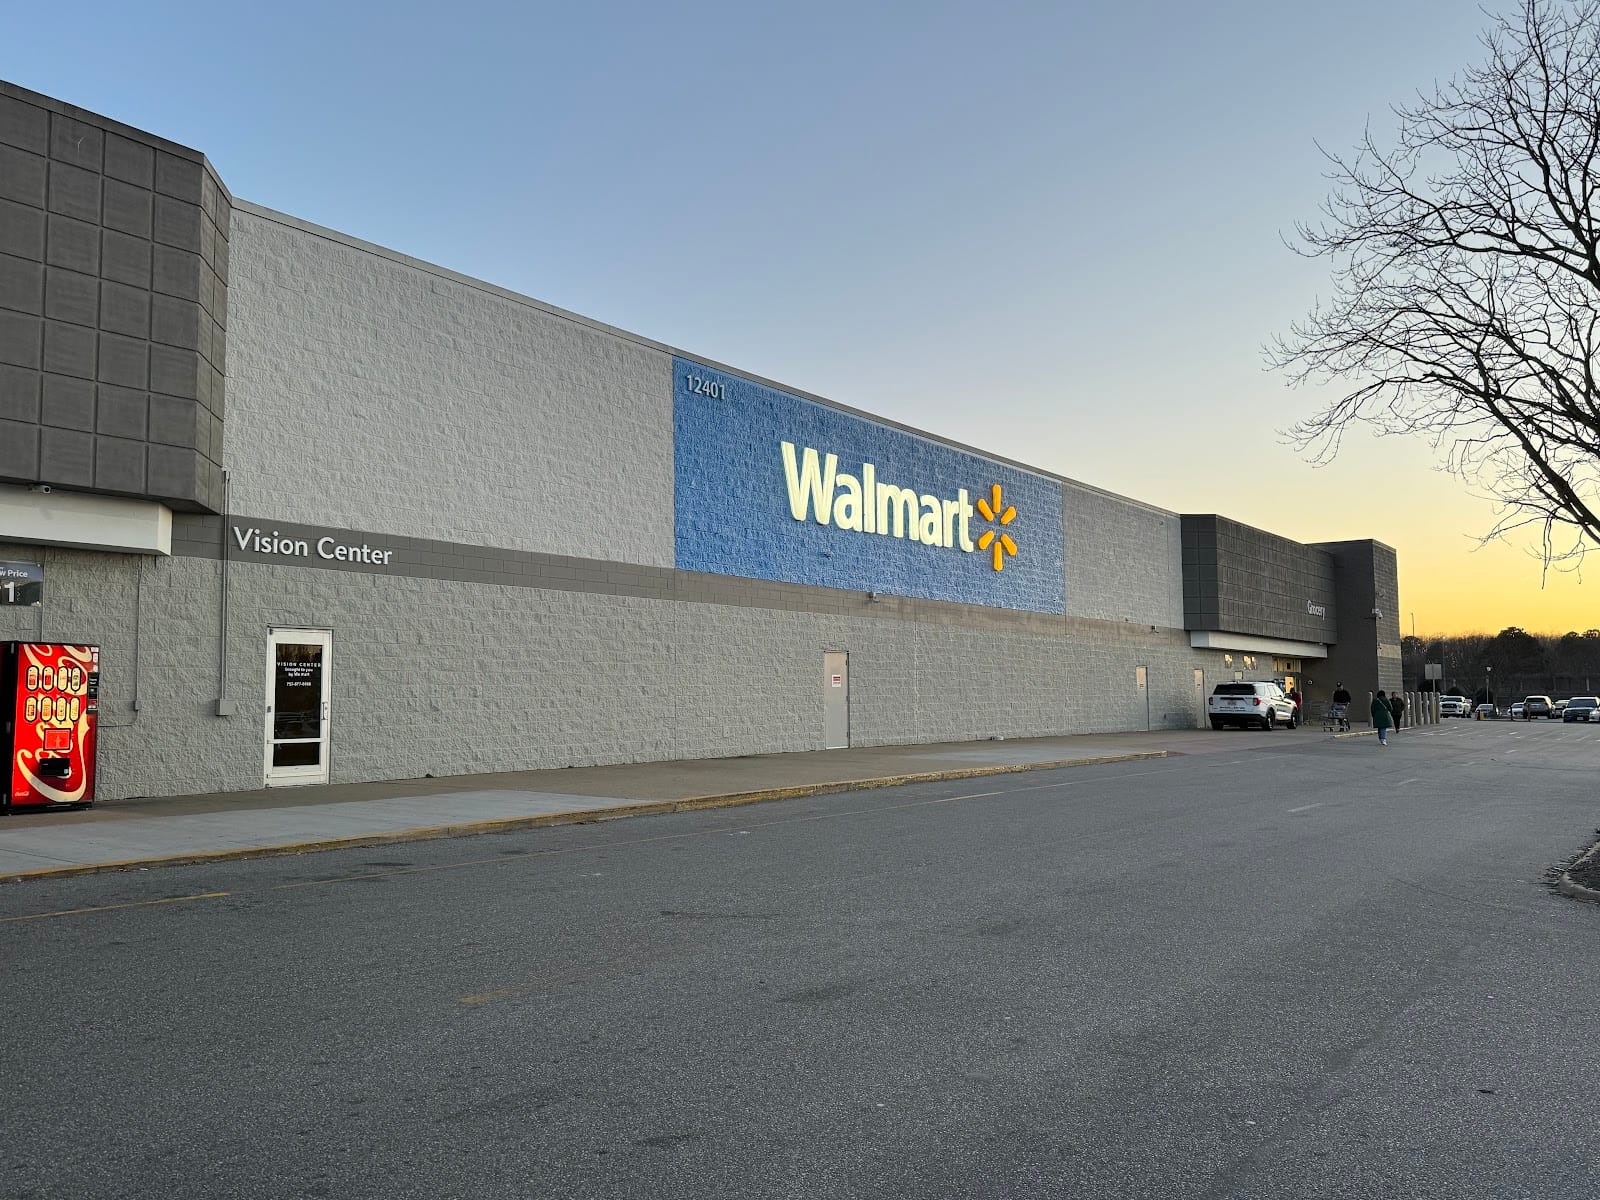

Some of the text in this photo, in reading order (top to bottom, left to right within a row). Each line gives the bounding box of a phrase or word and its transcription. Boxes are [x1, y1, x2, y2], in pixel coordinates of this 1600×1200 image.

[687, 374, 725, 400] 12401
[781, 441, 974, 552] Walmart
[233, 526, 392, 565] Vision Center
[7, 569, 28, 578] Price
[1307, 599, 1325, 621] Grocery
